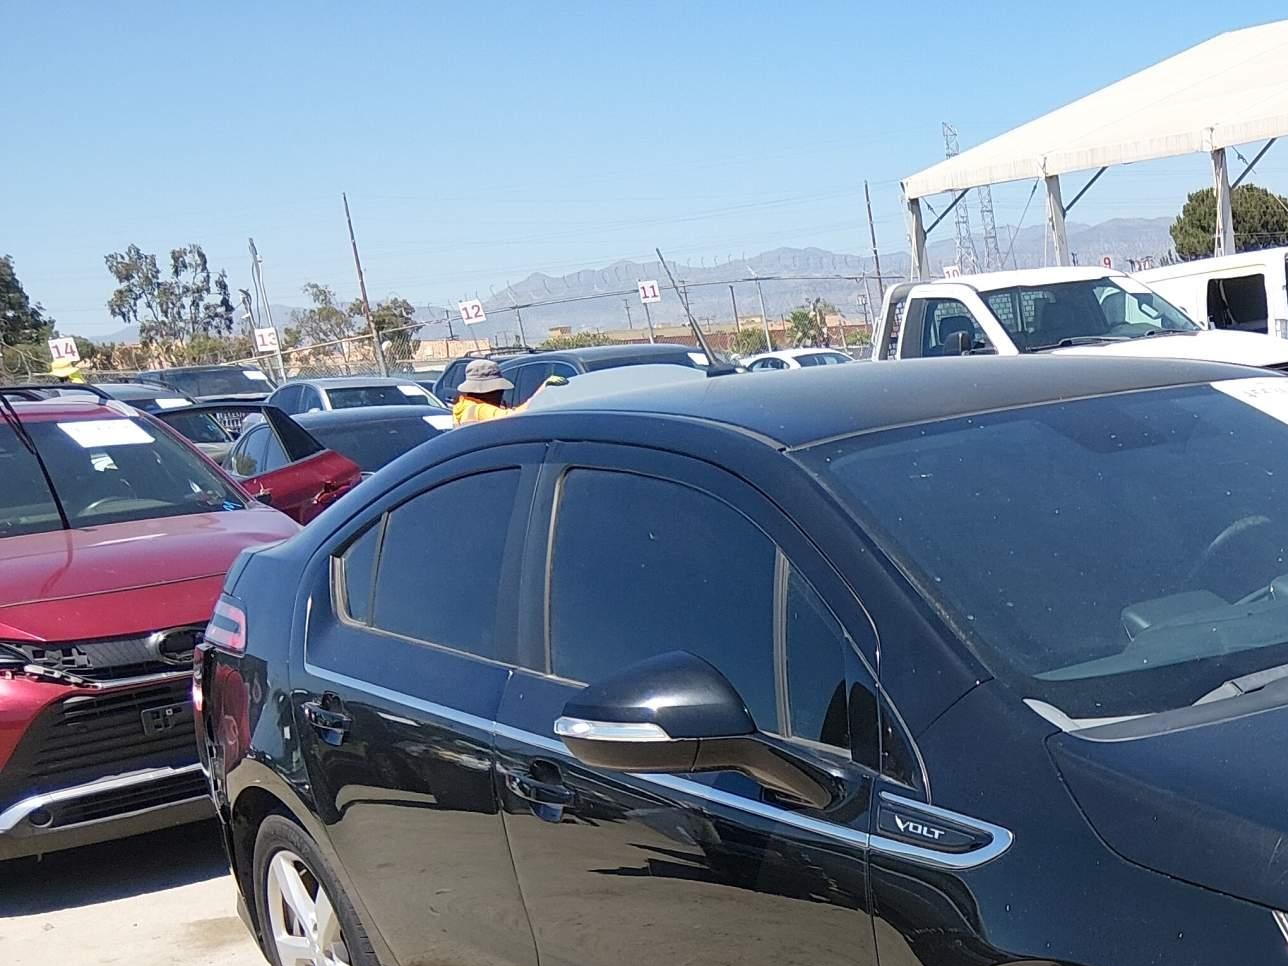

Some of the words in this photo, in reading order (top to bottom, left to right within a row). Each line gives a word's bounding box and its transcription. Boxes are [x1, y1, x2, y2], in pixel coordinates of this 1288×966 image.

[1103, 256, 1112, 269] 9
[640, 285, 658, 299] 11
[462, 304, 484, 320] 12
[258, 332, 278, 347] 13
[52, 342, 76, 359] 14
[895, 815, 945, 840] VOLT
